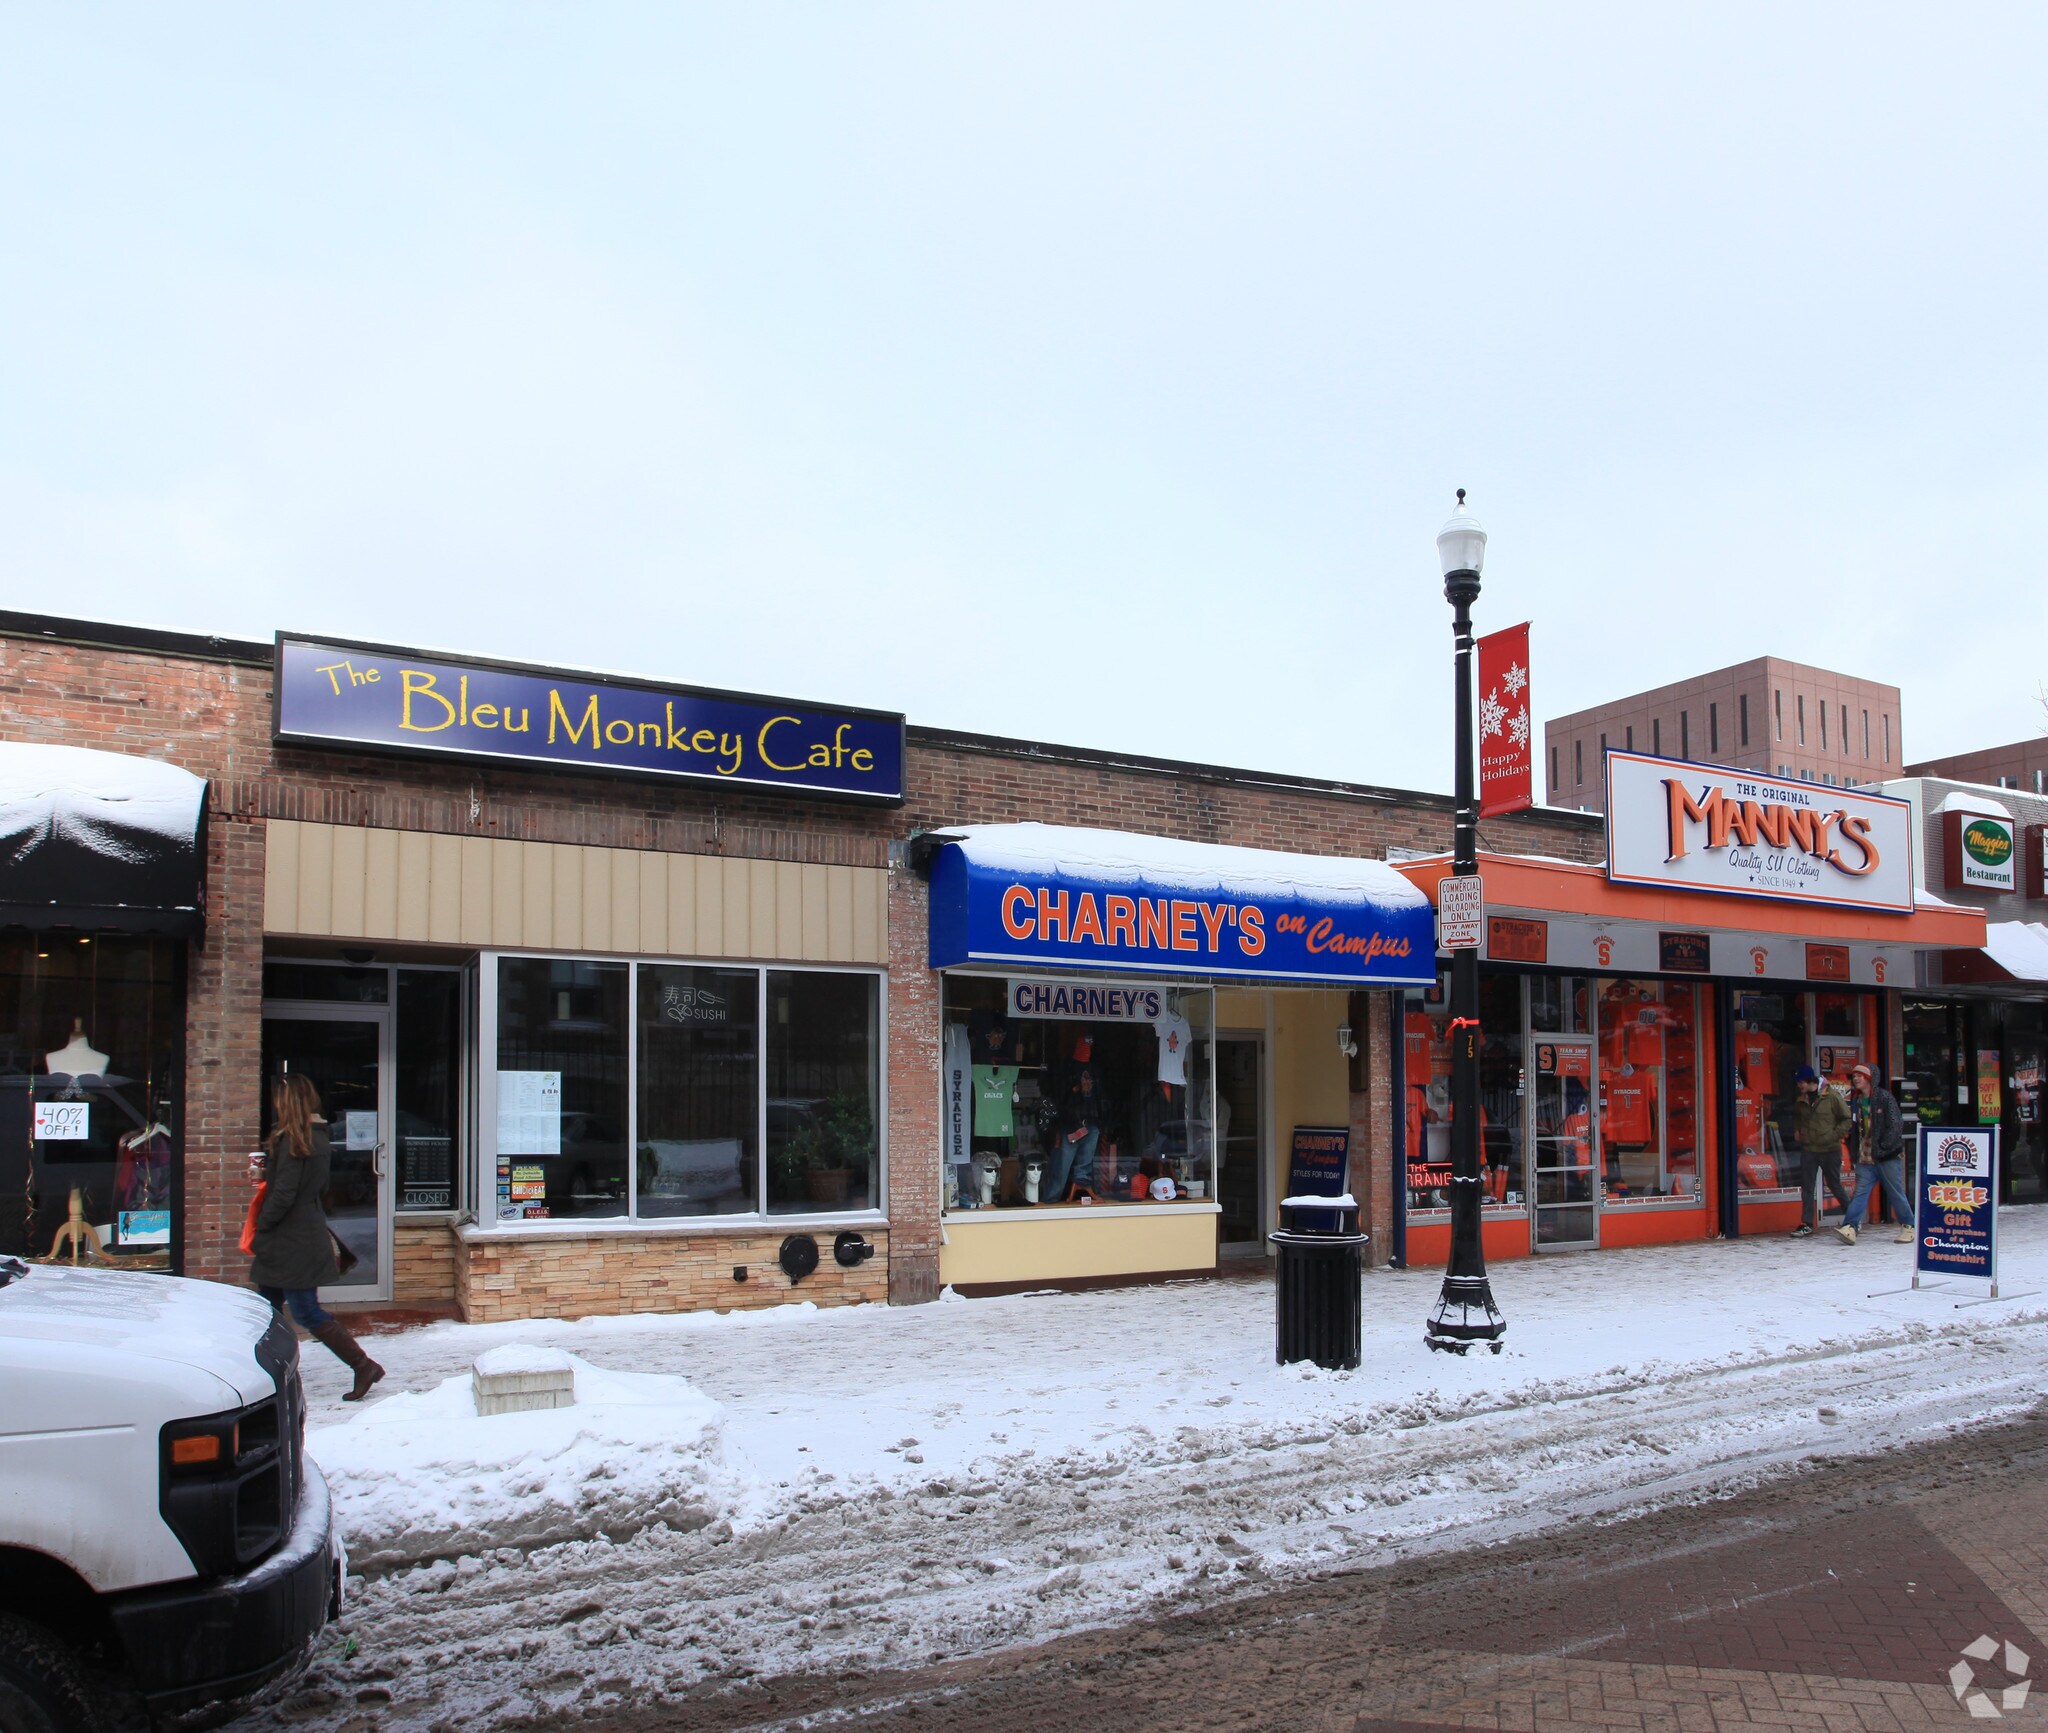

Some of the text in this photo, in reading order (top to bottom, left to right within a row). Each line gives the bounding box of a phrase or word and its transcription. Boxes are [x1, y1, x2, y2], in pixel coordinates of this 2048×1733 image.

[315, 661, 875, 776] The Bleu Monkey Cafe
[1482, 752, 1520, 766] Happy
[1482, 764, 1529, 781] Holidays
[1736, 783, 1810, 805] THE ORIGINAL
[1660, 778, 1879, 876] MANNY'S
[1968, 830, 2010, 856] Maggies
[1729, 849, 1820, 881] Quality SU Clothing
[1758, 875, 1796, 889] SINCE 1949
[1966, 866, 2011, 883] Restaurant
[1443, 882, 1480, 894] COMMERCIAL
[1444, 892, 1478, 903] LOADING
[1443, 902, 1480, 912] UNLOADING
[1001, 884, 1412, 966] CHARNEY'S on Campus
[1451, 912, 1472, 921] ONLY
[1598, 943, 1610, 966] S
[1754, 953, 1765, 974] S
[1875, 963, 1885, 983] S
[664, 985, 697, 1006] 寿司
[1014, 982, 1162, 1019] CHARNEY'S
[694, 1009, 726, 1020] SUSHI
[1539, 1045, 1552, 1069] S
[1980, 1083, 1995, 1092] SOFT
[1982, 1093, 1993, 1104] ICE
[43, 1107, 83, 1124] 40%
[952, 1070, 963, 1156] SYRACUSE
[1295, 1136, 1345, 1151] CHARNEY'S
[1293, 1170, 1311, 1178] STYLES
[1408, 1163, 1428, 1173] THE
[405, 1191, 449, 1204] CLOSED
[1162, 1186, 1169, 1194] S
[1927, 1184, 1988, 1205] FREE
[1943, 1213, 1972, 1227] Gift
[1952, 1228, 1986, 1237] purchase
[1924, 1236, 1989, 1253] Champion
[1927, 1251, 1986, 1264] Sweatshirt
